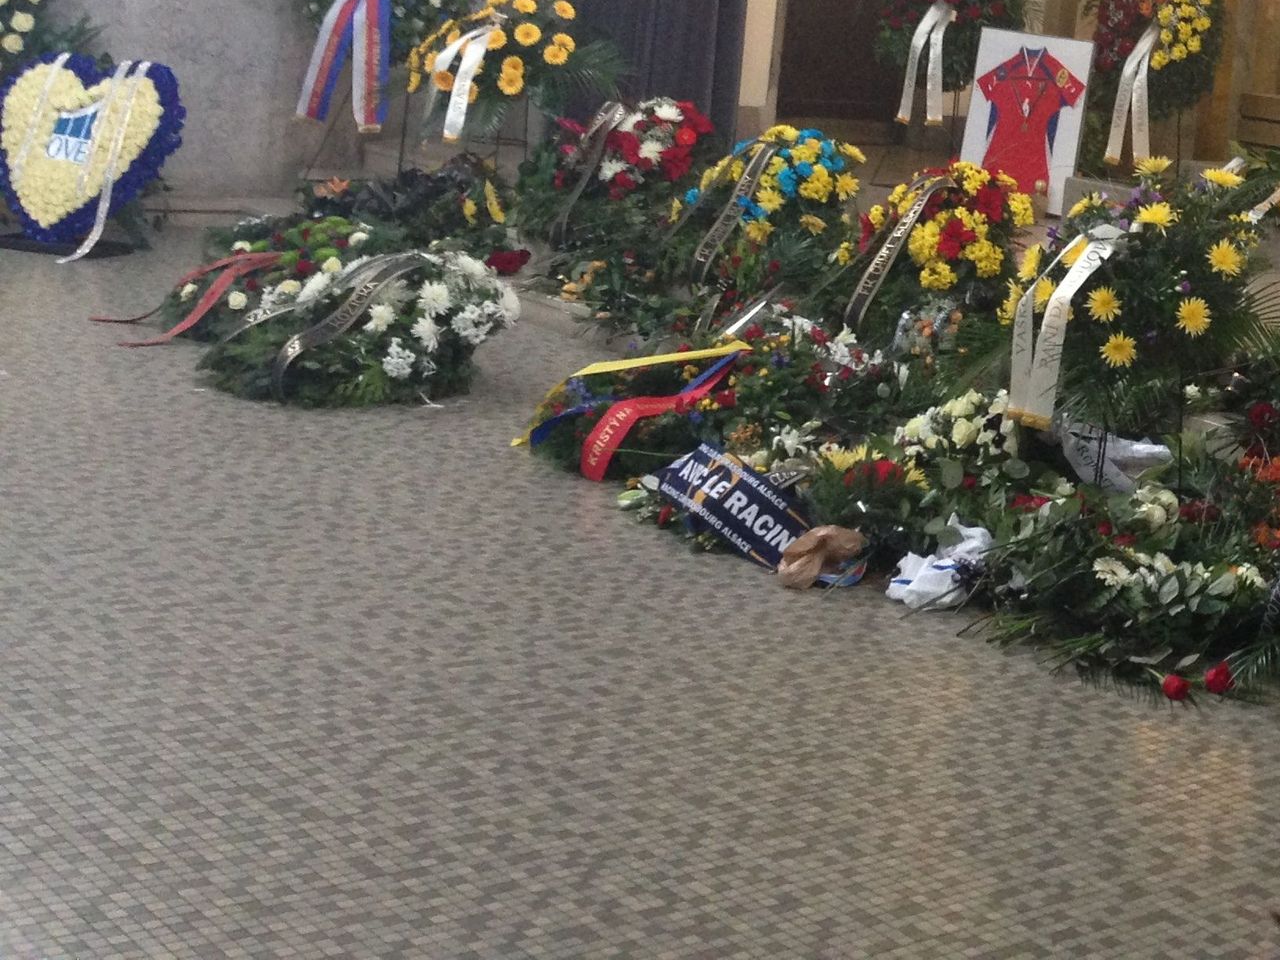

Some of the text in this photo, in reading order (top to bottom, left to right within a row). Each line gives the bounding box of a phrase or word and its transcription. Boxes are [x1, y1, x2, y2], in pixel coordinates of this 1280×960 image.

[757, 484, 787, 511] ALSACE
[701, 475, 732, 500] LE
[723, 490, 799, 554] RACIN
[721, 525, 752, 554] ALSACE
